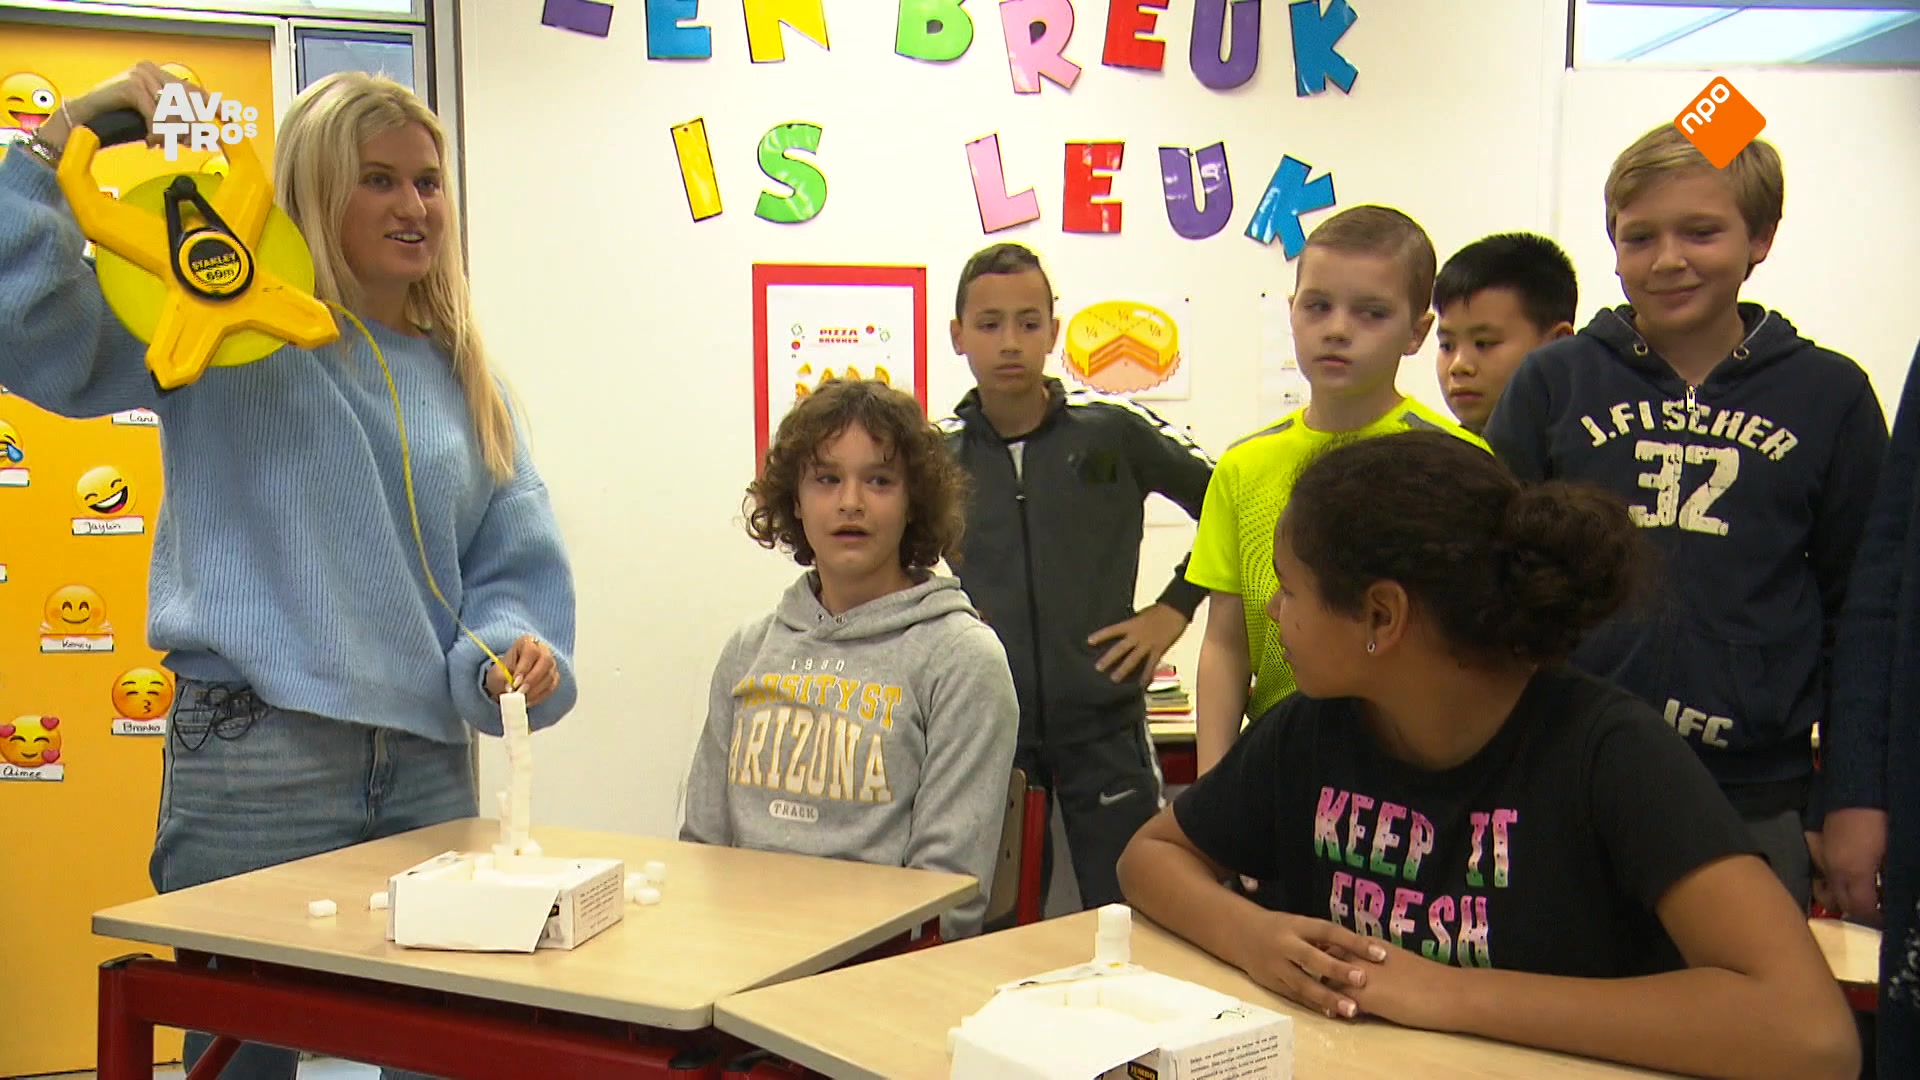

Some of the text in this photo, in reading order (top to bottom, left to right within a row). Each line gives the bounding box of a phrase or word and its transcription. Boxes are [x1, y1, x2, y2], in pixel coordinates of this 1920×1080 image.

[894, 0, 1359, 97] BREUK
[670, 117, 1337, 261] IS LEUK
[192, 252, 237, 271] STANLEY
[819, 328, 858, 336] PIZZA
[1627, 439, 1740, 537] 32
[728, 706, 894, 802] ARIZONA
[773, 802, 817, 820] TRACK
[1315, 785, 1519, 888] KEEP IT
[1329, 871, 1492, 968] FRESH
